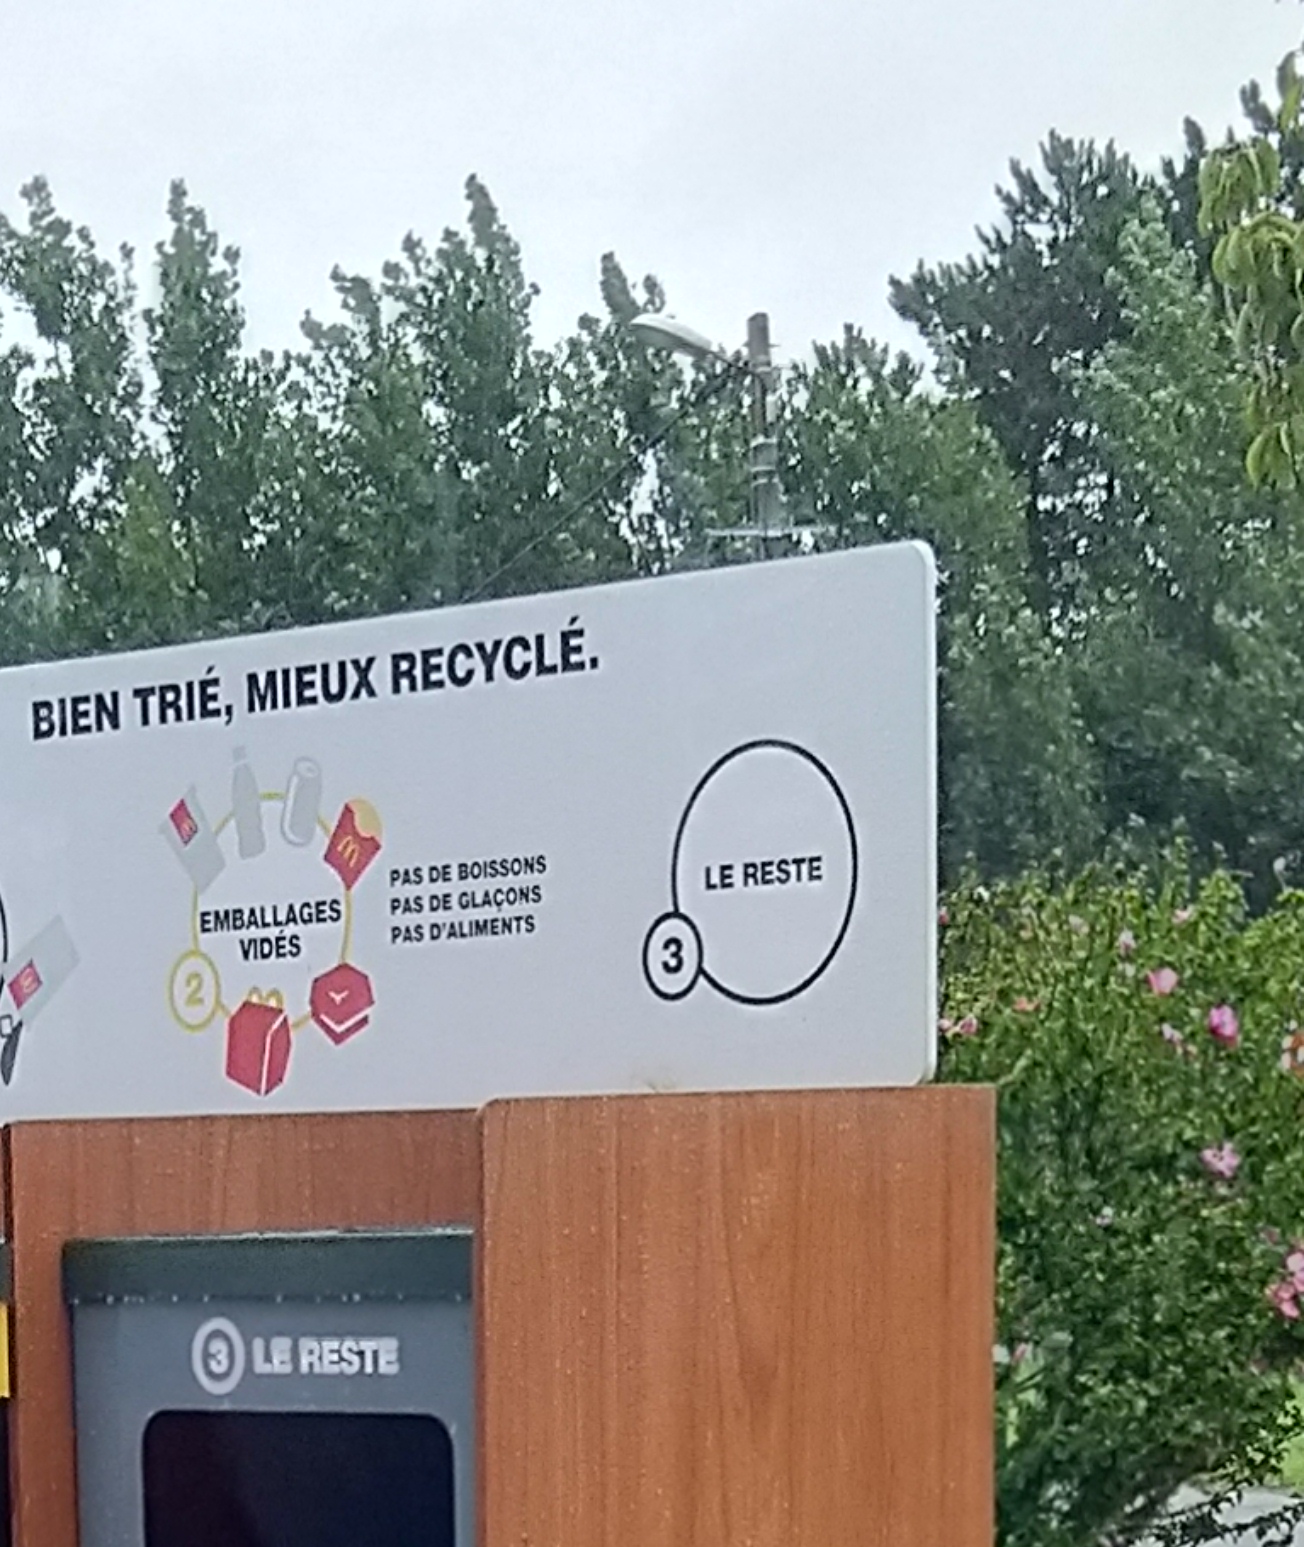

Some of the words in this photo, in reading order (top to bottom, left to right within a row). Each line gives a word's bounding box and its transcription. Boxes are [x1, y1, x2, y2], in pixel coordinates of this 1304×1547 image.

[32, 690, 121, 740] BIEN
[133, 667, 234, 727] TRIÉ,
[246, 655, 377, 714] MIEUX
[391, 616, 599, 694] RECYCLÉ.
[390, 867, 424, 887] PAS
[428, 864, 453, 883] DE
[457, 854, 548, 881] BOISSONS
[704, 865, 735, 891] LE
[742, 856, 823, 887] RESTE
[199, 899, 343, 934] EMBALLAGES
[390, 896, 424, 916] PAS
[428, 892, 453, 912] DE
[457, 884, 543, 913] GLAÇONS
[391, 924, 425, 944] PAS
[429, 914, 536, 942] D'ALIMENTS
[239, 932, 302, 962] VIDÉS
[661, 937, 685, 975] 3
[184, 972, 206, 1001] 2
[208, 1344, 228, 1373] 3
[253, 1338, 293, 1374] LE
[300, 1338, 400, 1374] RESTE
